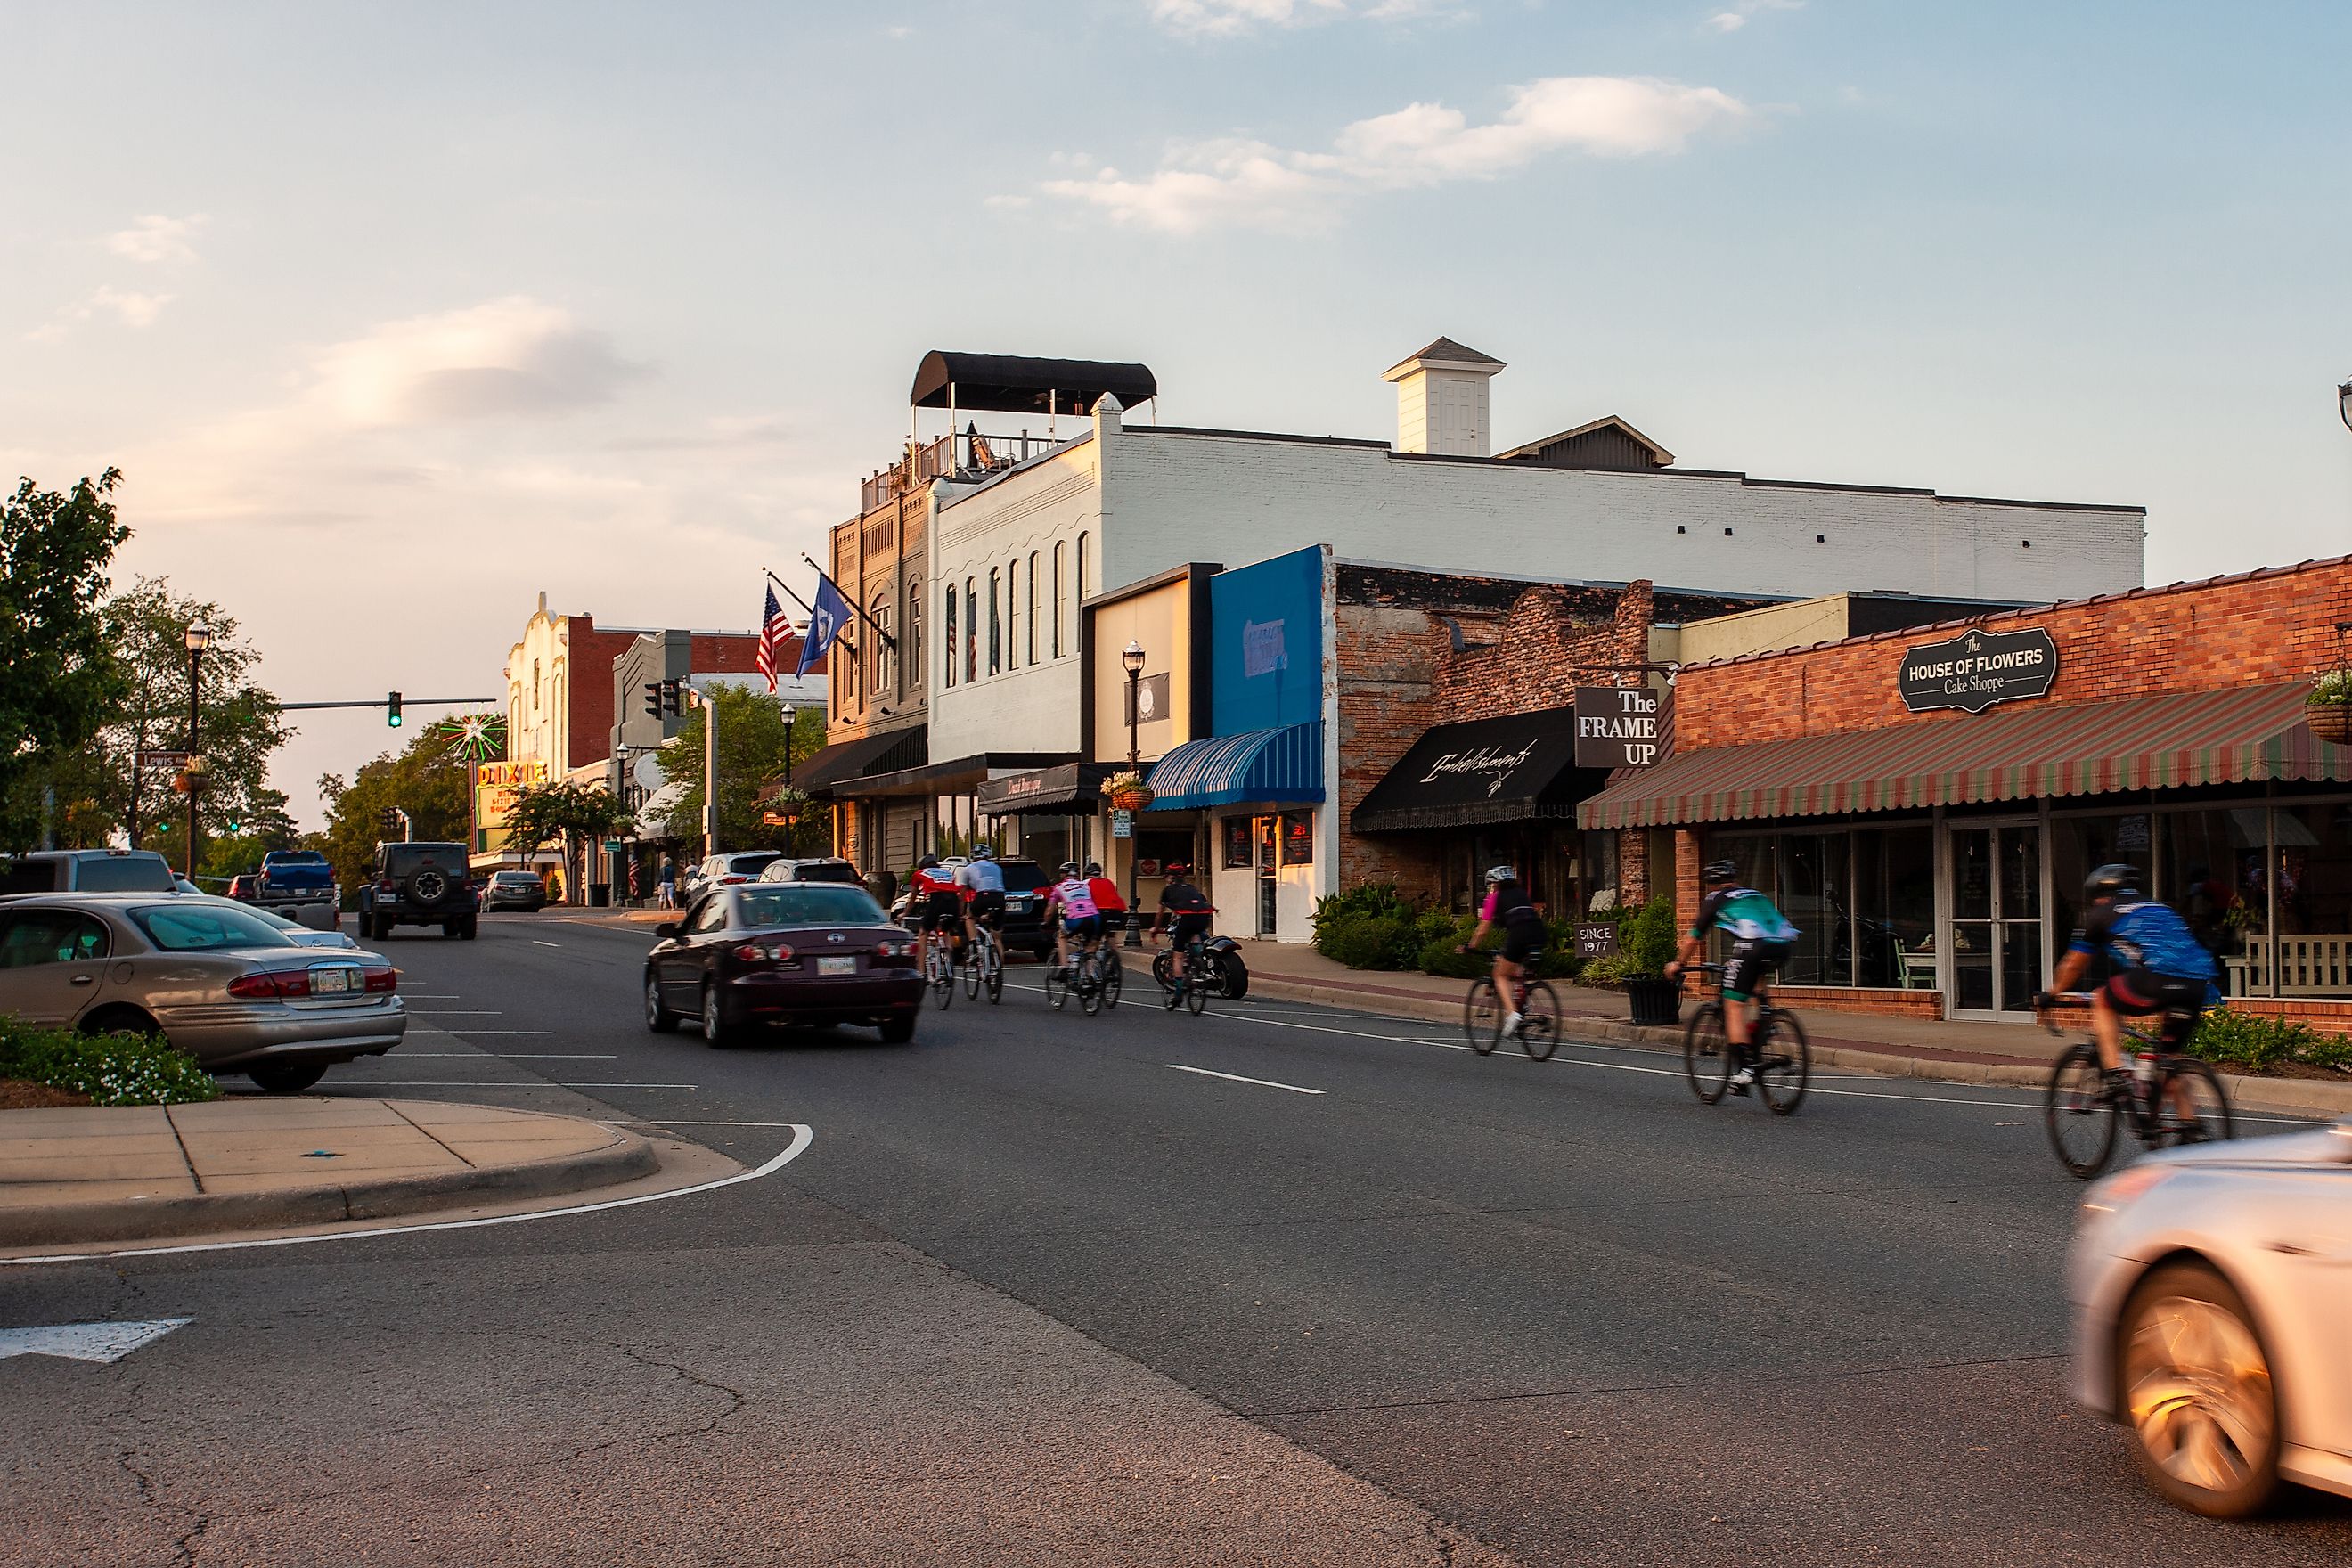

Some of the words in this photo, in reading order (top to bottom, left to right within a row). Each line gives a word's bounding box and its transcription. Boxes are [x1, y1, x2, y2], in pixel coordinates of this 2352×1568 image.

[1965, 635, 1982, 654] The
[1908, 661, 1954, 682] HOUSE
[1956, 658, 1974, 675] OF
[1976, 649, 2044, 673] FLOWERS
[1944, 678, 1968, 696] Cake
[1969, 675, 2005, 695] Shoppe
[1618, 690, 1657, 714] The
[1578, 716, 1658, 739] FRAME
[144, 755, 174, 766] Lewis
[1623, 743, 1657, 764] UP
[478, 760, 547, 785] DIXIE
[1579, 927, 1613, 940] SINCE
[1583, 941, 1608, 952] 1977
